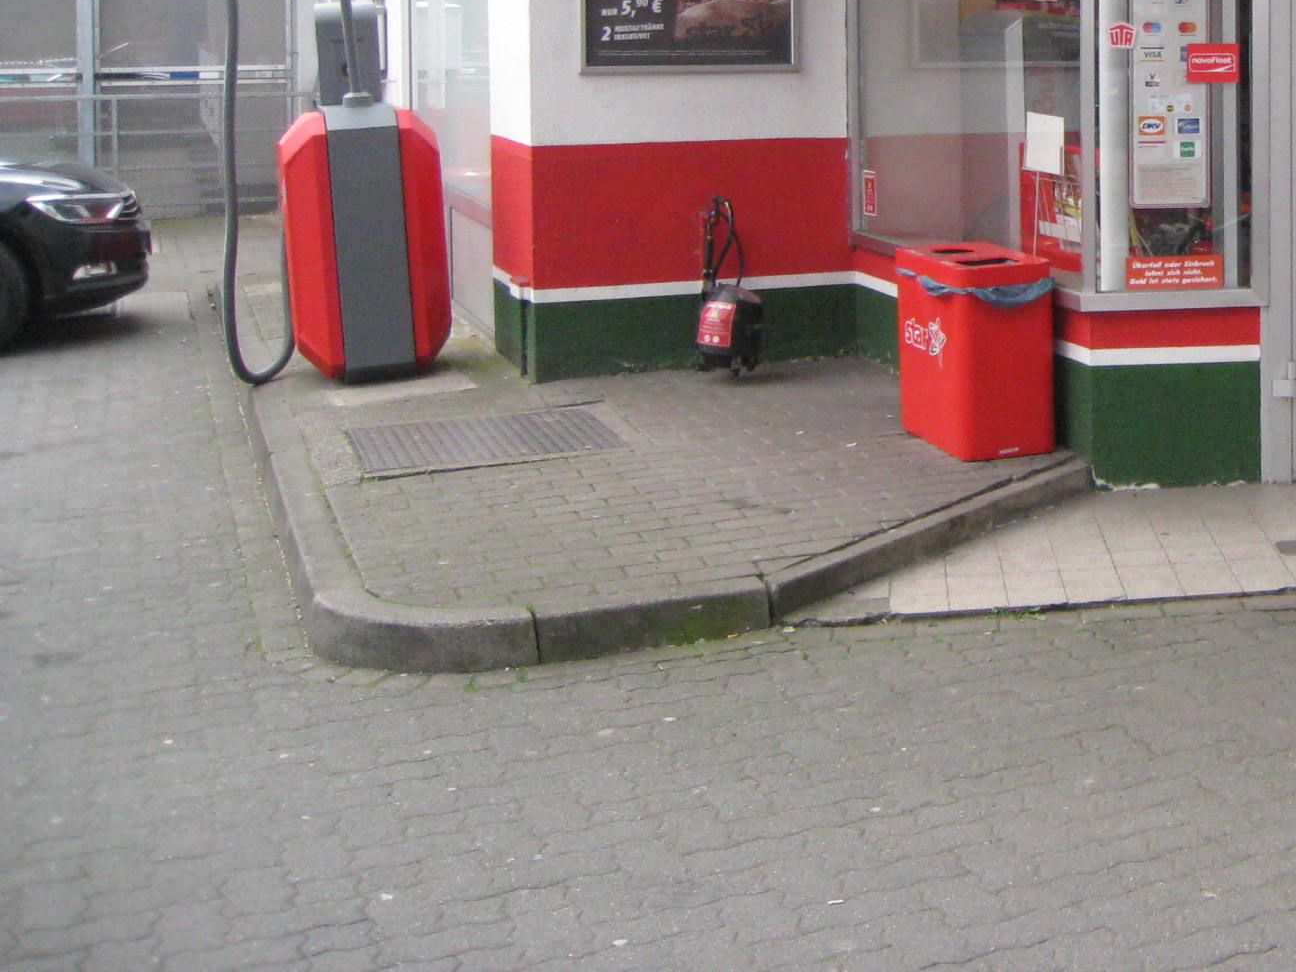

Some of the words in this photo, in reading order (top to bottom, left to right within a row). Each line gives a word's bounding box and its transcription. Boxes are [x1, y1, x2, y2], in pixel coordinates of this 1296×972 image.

[601, 26, 612, 41] 2
[1109, 25, 1135, 46] UTA
[1144, 51, 1162, 59] VISA
[1142, 122, 1162, 130] DKV
